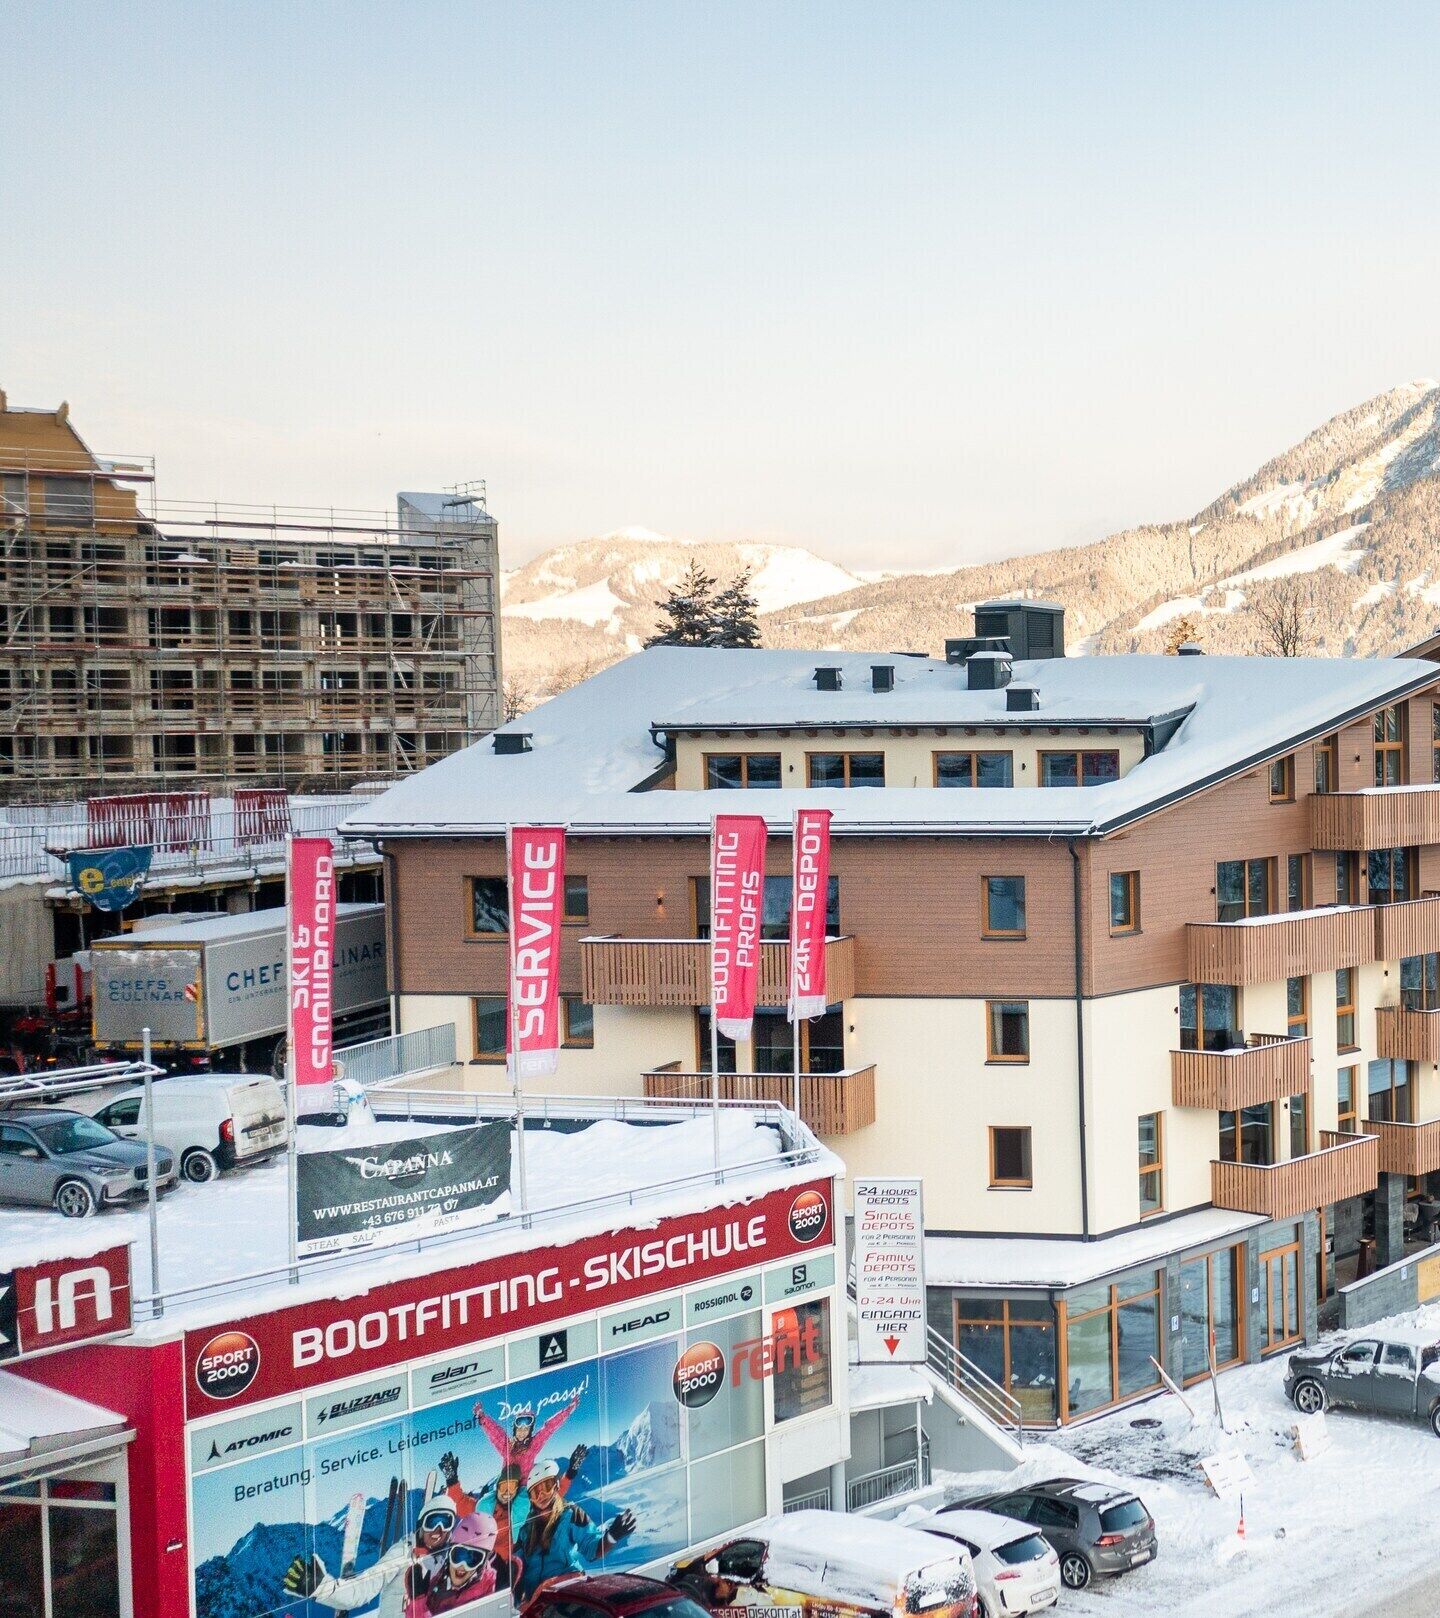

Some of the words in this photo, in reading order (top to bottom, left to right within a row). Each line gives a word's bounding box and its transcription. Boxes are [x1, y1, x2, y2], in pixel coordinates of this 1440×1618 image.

[798, 817, 821, 912] DEPOT
[736, 870, 760, 968] PROFIS
[517, 842, 557, 1039] SERVICE
[109, 979, 167, 991] CHEFS
[226, 962, 284, 992] CHEF
[109, 991, 184, 1003] CULINAR
[360, 1150, 453, 1179] CAPANNA
[313, 1175, 499, 1220] WWW.RESTAURANTCAPANNA.AT
[857, 1186, 878, 1196] 24
[881, 1188, 918, 1196] HOURS
[866, 1197, 910, 1205] DEPOTS
[362, 1214, 382, 1226] +43
[384, 1210, 405, 1222] 676
[407, 1206, 424, 1220] 911
[792, 1203, 823, 1221] SPORT
[795, 1214, 821, 1230] 2000
[861, 1222, 915, 1231] DEPOTS
[307, 1238, 340, 1252] STEAK
[863, 1264, 916, 1272] DEPOTS
[694, 1293, 738, 1312] ROSSIGNOL
[612, 1310, 670, 1335] HEAD
[861, 1310, 922, 1319] EINGANG
[876, 1322, 908, 1331] HIER
[201, 1347, 253, 1371] SPORT
[732, 1315, 822, 1390] rent
[206, 1362, 249, 1384] 2000
[431, 1363, 478, 1383] elan
[677, 1356, 720, 1381] SPORT
[681, 1371, 717, 1393] 2000
[330, 1386, 402, 1414] BLIZZARD
[497, 1400, 532, 1420] Das
[536, 1374, 589, 1416] passt!
[224, 1426, 293, 1454] ATOMIC
[233, 1469, 316, 1502] Beratung.
[321, 1447, 383, 1475] Service.
